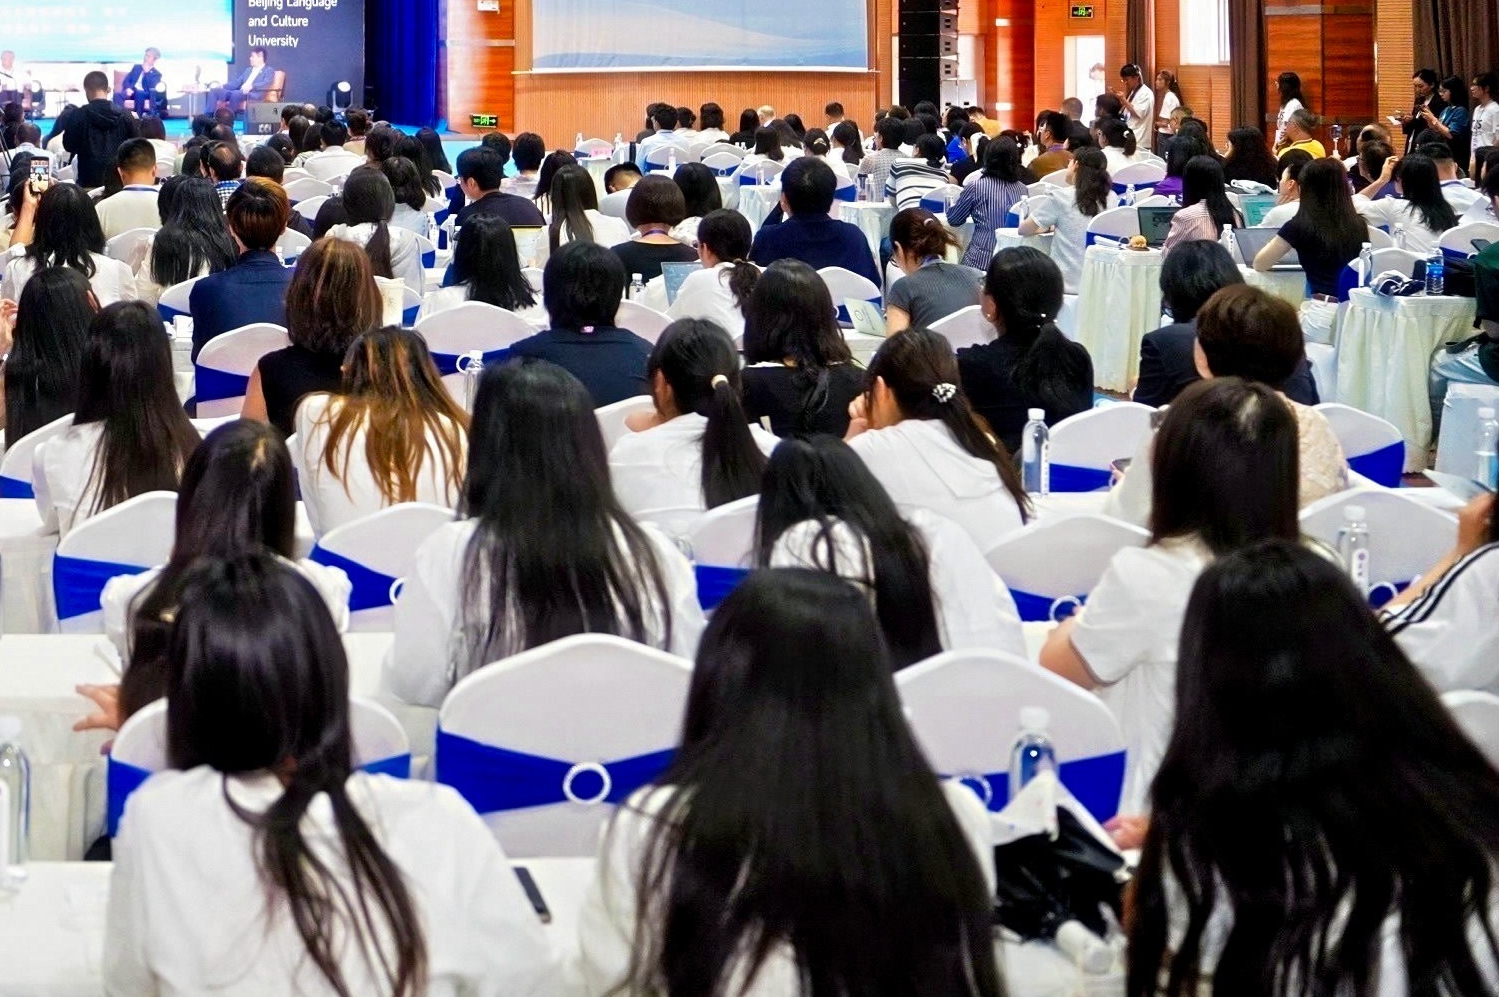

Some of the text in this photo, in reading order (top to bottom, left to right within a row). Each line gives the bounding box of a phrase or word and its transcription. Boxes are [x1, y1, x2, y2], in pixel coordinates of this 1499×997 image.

[248, 14, 309, 27] and Culture
[248, 34, 299, 48] University
